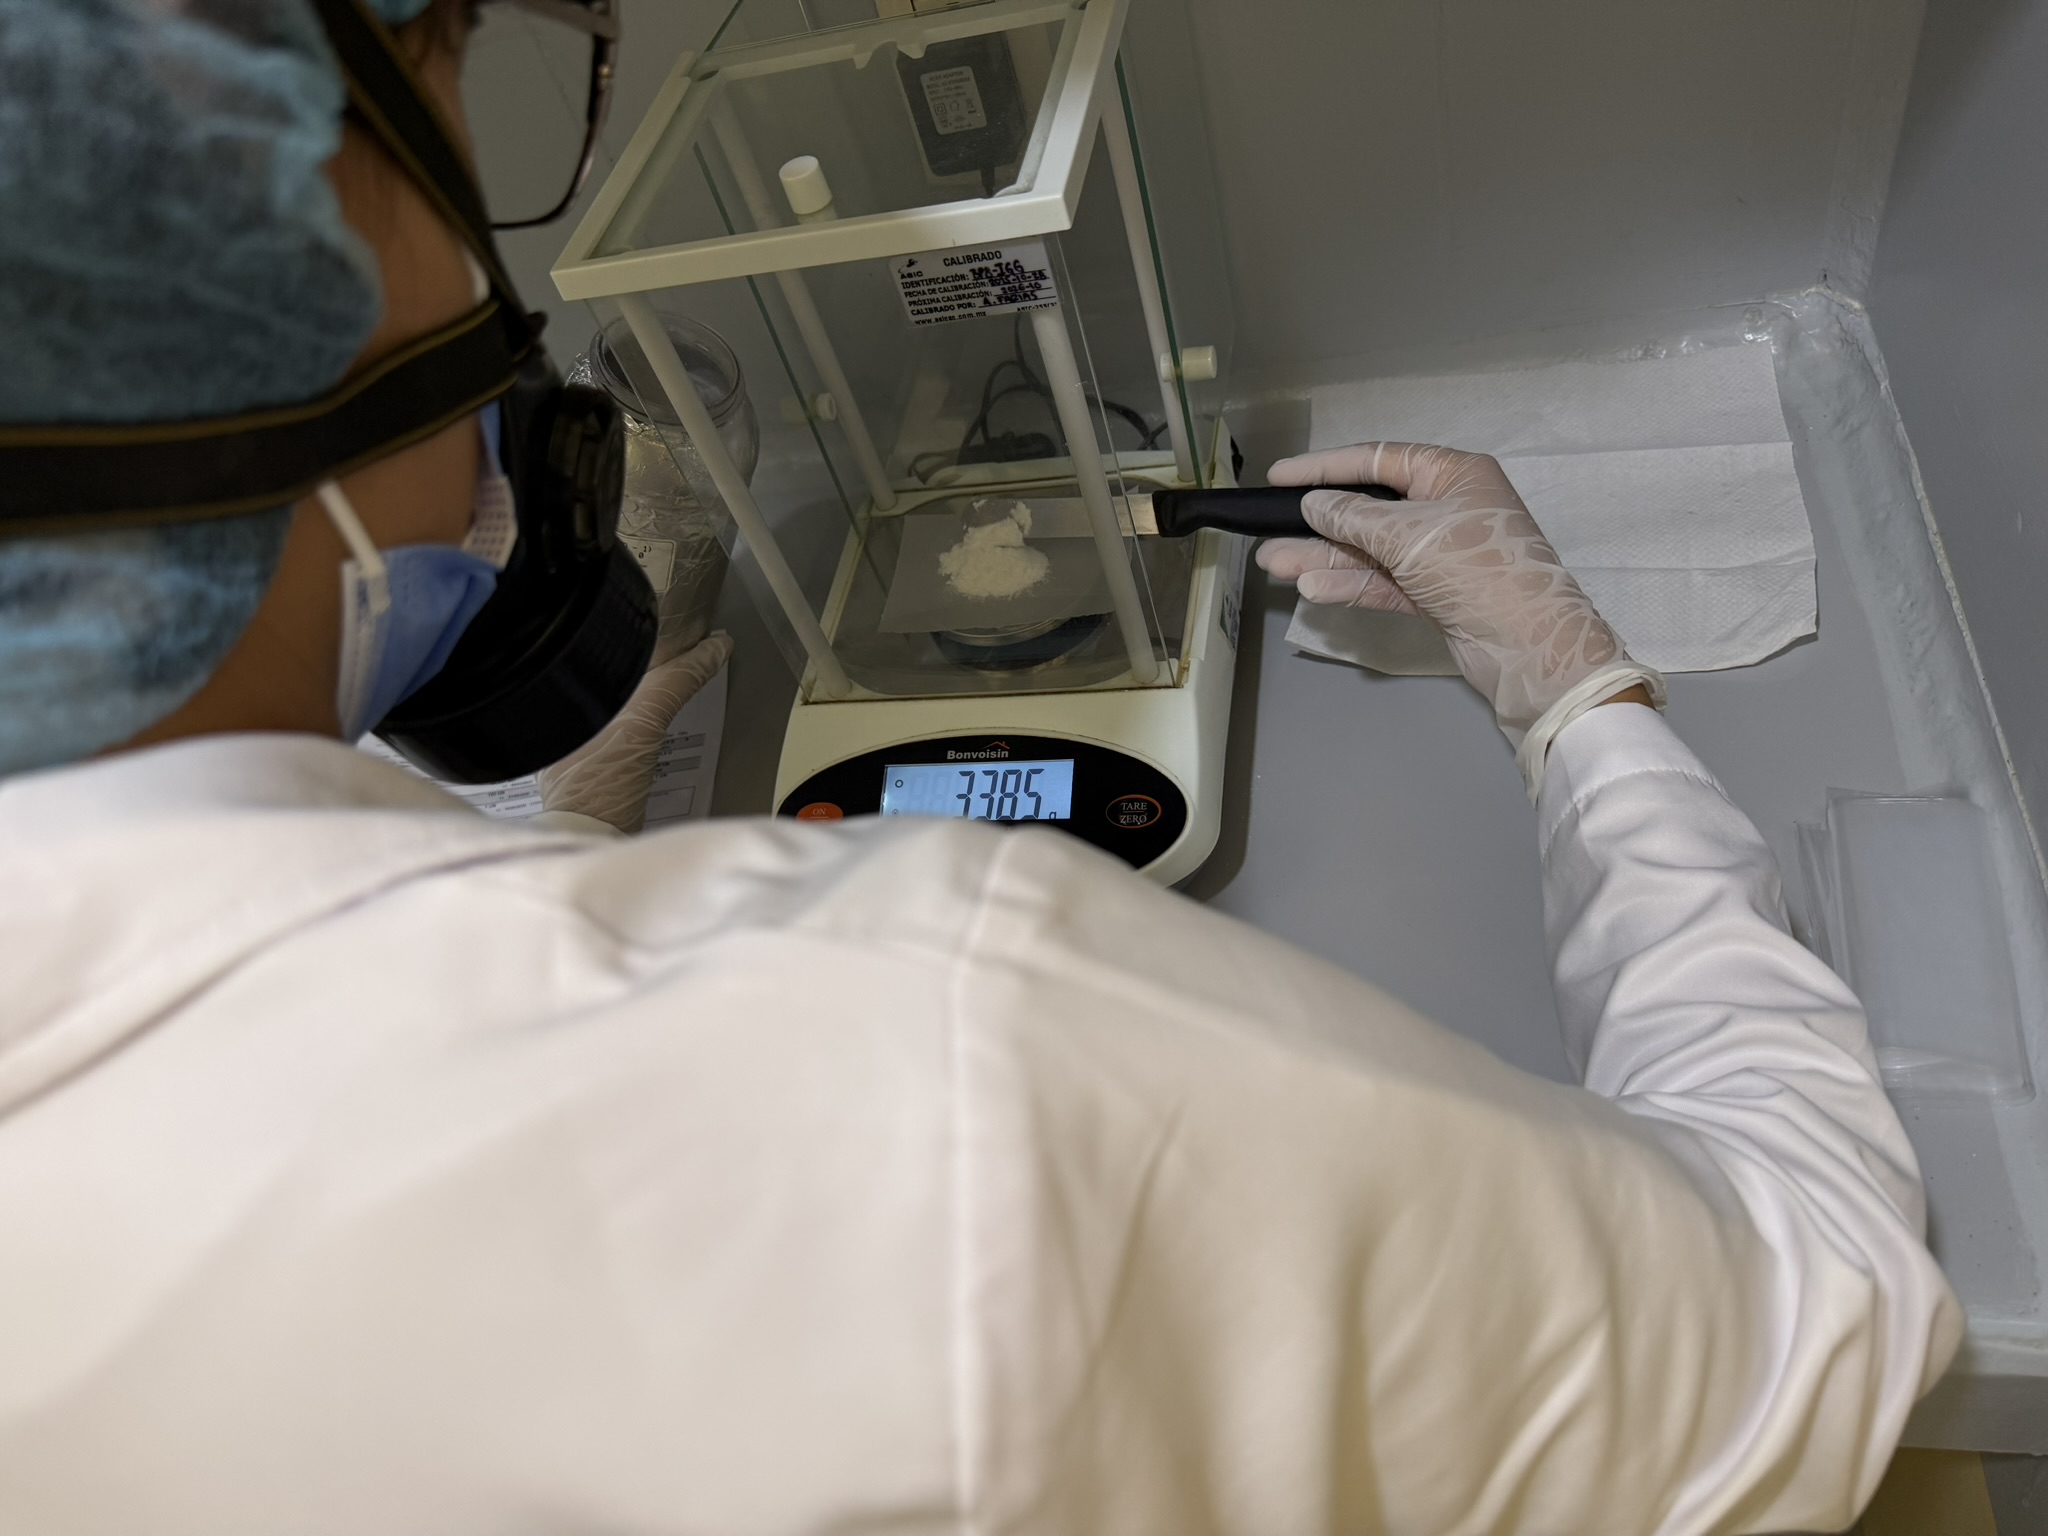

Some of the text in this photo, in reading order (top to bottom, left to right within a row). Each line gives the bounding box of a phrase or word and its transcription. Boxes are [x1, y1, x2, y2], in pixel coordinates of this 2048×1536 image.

[943, 250, 1002, 267] CALIBRADO
[900, 270, 923, 279] ASIC
[901, 273, 969, 289] IDENTIFICACIÓN:
[904, 280, 989, 298] FECHA DE CALIBRACIÓN:
[908, 290, 993, 308] PRÓXIMA CALIBRACIÓN:
[911, 301, 977, 316] CALIBRADO POR:
[946, 748, 1009, 760] Bonvoisin
[812, 807, 827, 816] ON
[1120, 801, 1148, 811] TARE
[1119, 814, 1148, 826] ZERO
